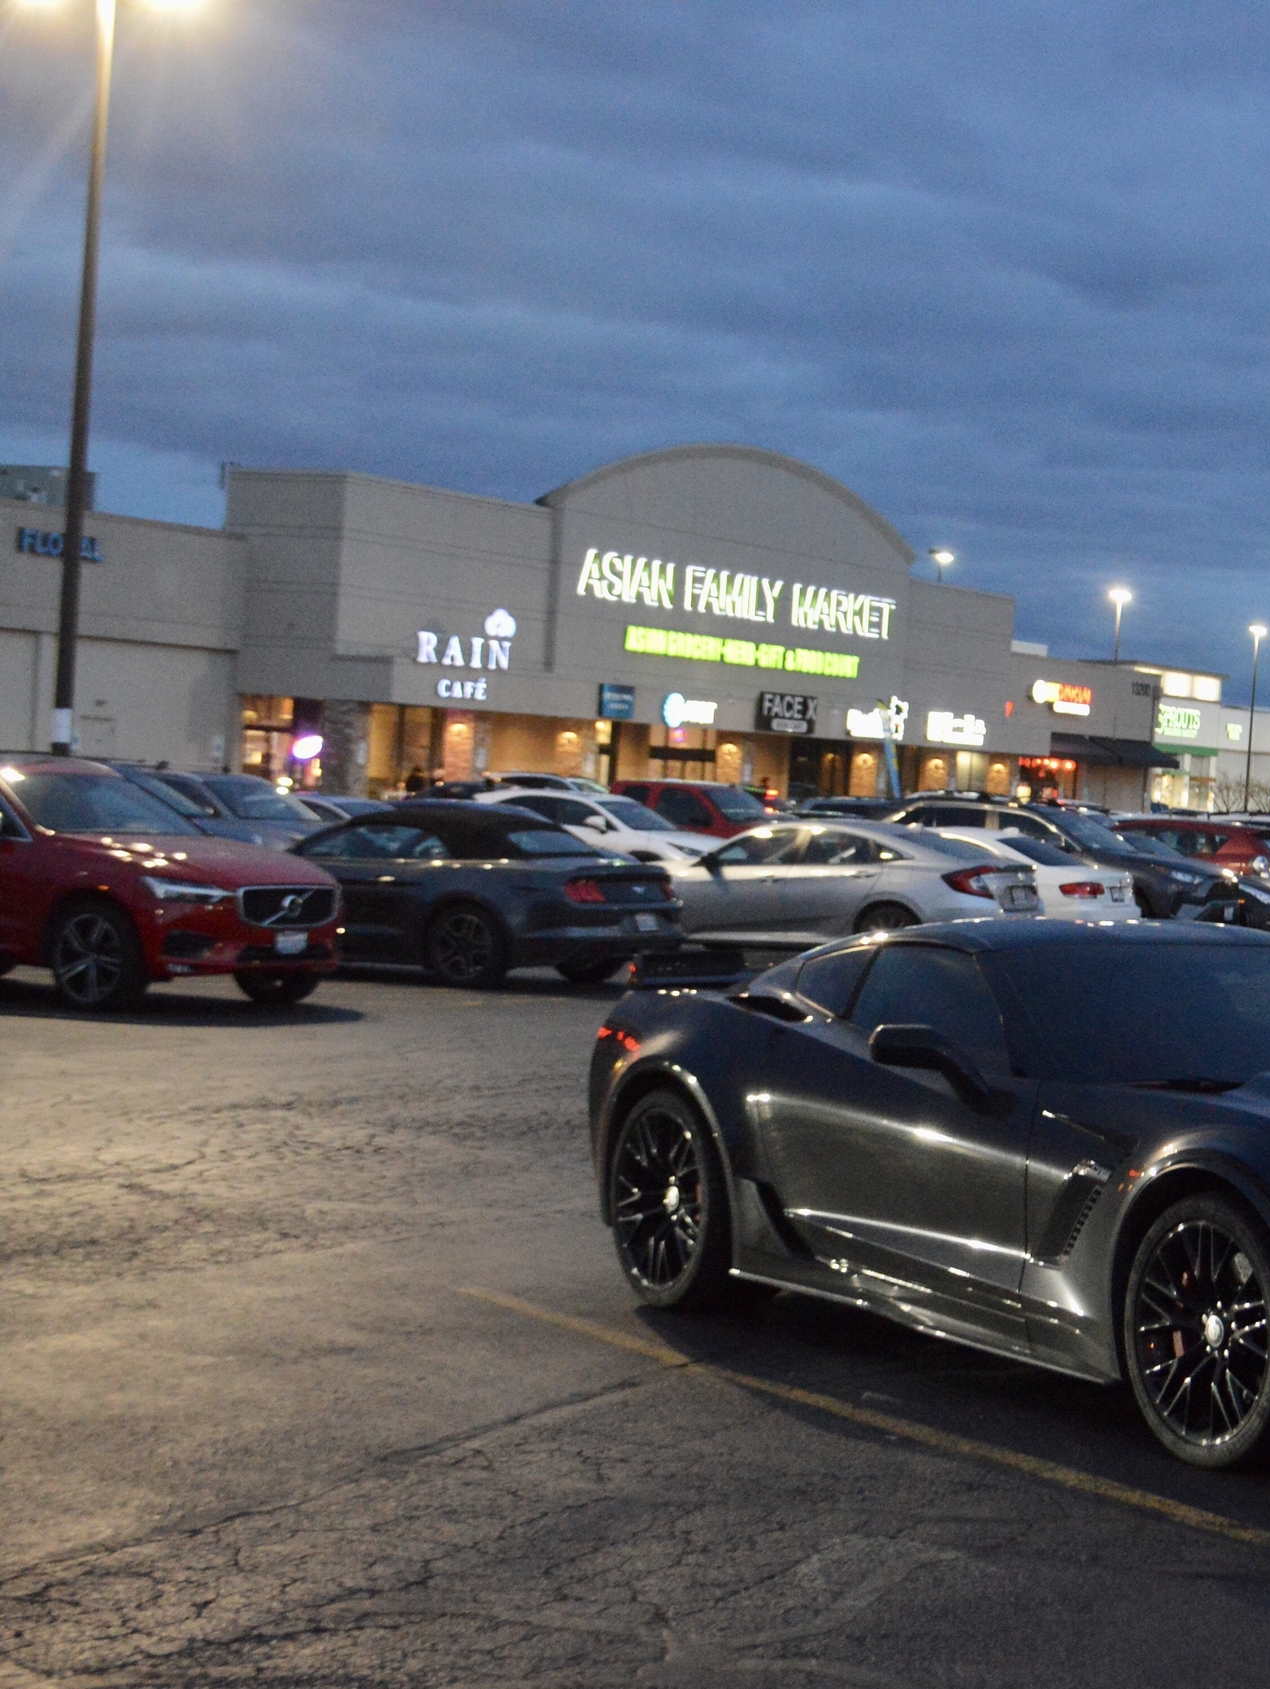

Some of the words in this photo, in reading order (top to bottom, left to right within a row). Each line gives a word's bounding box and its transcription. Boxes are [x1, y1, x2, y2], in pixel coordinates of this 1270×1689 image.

[20, 527, 104, 562] FLOAL
[577, 548, 676, 609] ASIAN
[684, 565, 785, 623] FAMILY
[791, 583, 896, 640] MARKET
[416, 630, 512, 670] RAIN
[437, 677, 487, 700] CAFÉ
[762, 693, 804, 719] FACE
[805, 698, 818, 720] X
